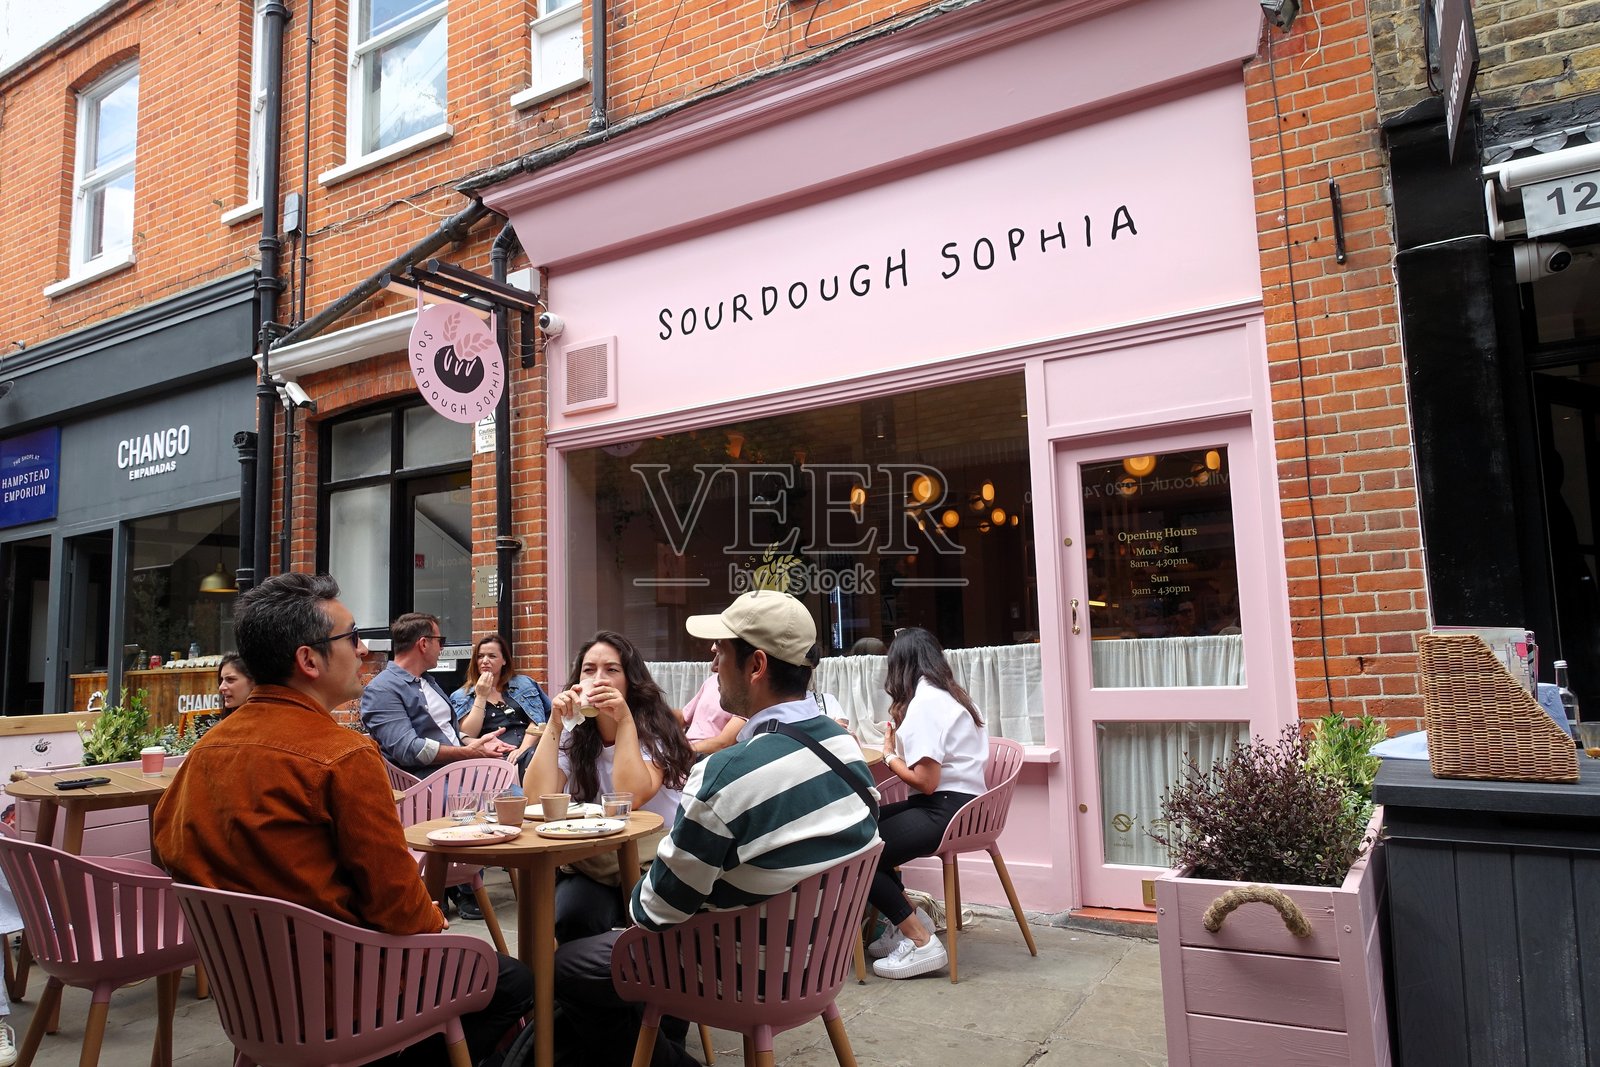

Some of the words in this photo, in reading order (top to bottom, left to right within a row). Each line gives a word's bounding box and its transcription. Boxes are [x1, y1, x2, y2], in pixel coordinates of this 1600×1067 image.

[658, 248, 909, 341] SOURDOUGH
[940, 205, 1138, 280] SOPHIA
[415, 330, 468, 416] SOURDOUGH
[475, 361, 501, 413] SOPHIA
[117, 424, 191, 470] CHANGO
[13, 457, 21, 466] THE
[21, 453, 34, 462] SHOPS
[2, 467, 50, 489] HAMPSTEAD
[129, 460, 177, 481] EMPANADAS
[4, 484, 46, 503] EMPORIUM
[1117, 530, 1163, 544] Opening
[1164, 527, 1198, 538] Hours
[1135, 546, 1157, 557] Mon
[1164, 545, 1179, 555] Sat
[1130, 557, 1149, 568] 8am
[1155, 556, 1189, 569] 4.30pm
[1150, 573, 1169, 583] Sun
[1131, 586, 1151, 598] 9am
[1157, 584, 1190, 597] 4.30pm
[178, 694, 222, 714] CHANG
